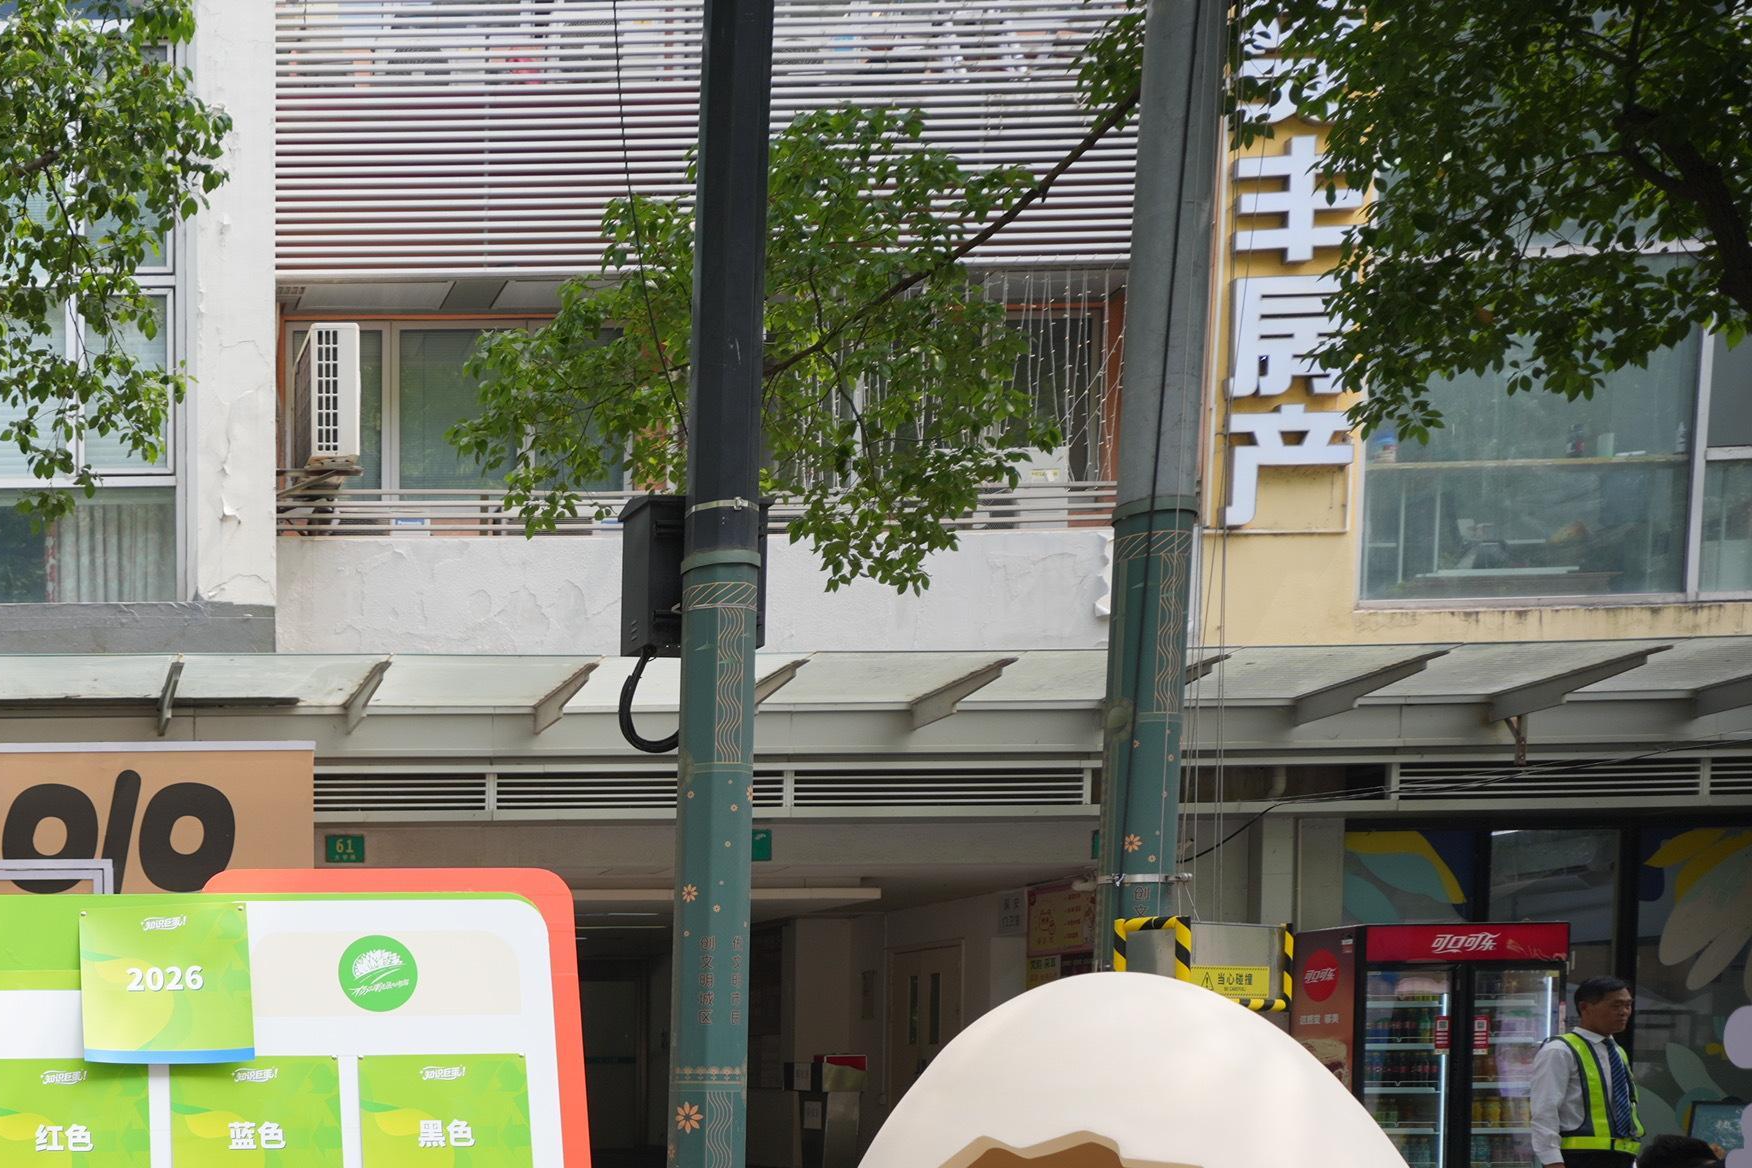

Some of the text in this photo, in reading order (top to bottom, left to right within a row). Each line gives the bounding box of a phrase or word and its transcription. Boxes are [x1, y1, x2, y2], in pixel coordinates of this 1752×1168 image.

[336, 838, 354, 853] 61
[1431, 932, 1501, 954] 可口可乐
[126, 965, 204, 993] 2026
[1218, 973, 1254, 985] 当心碰撞
[1304, 967, 1337, 984] 可口可乐
[35, 1124, 94, 1153] 红色
[228, 1121, 286, 1150] 蓝色
[418, 1119, 475, 1148] 黑色
